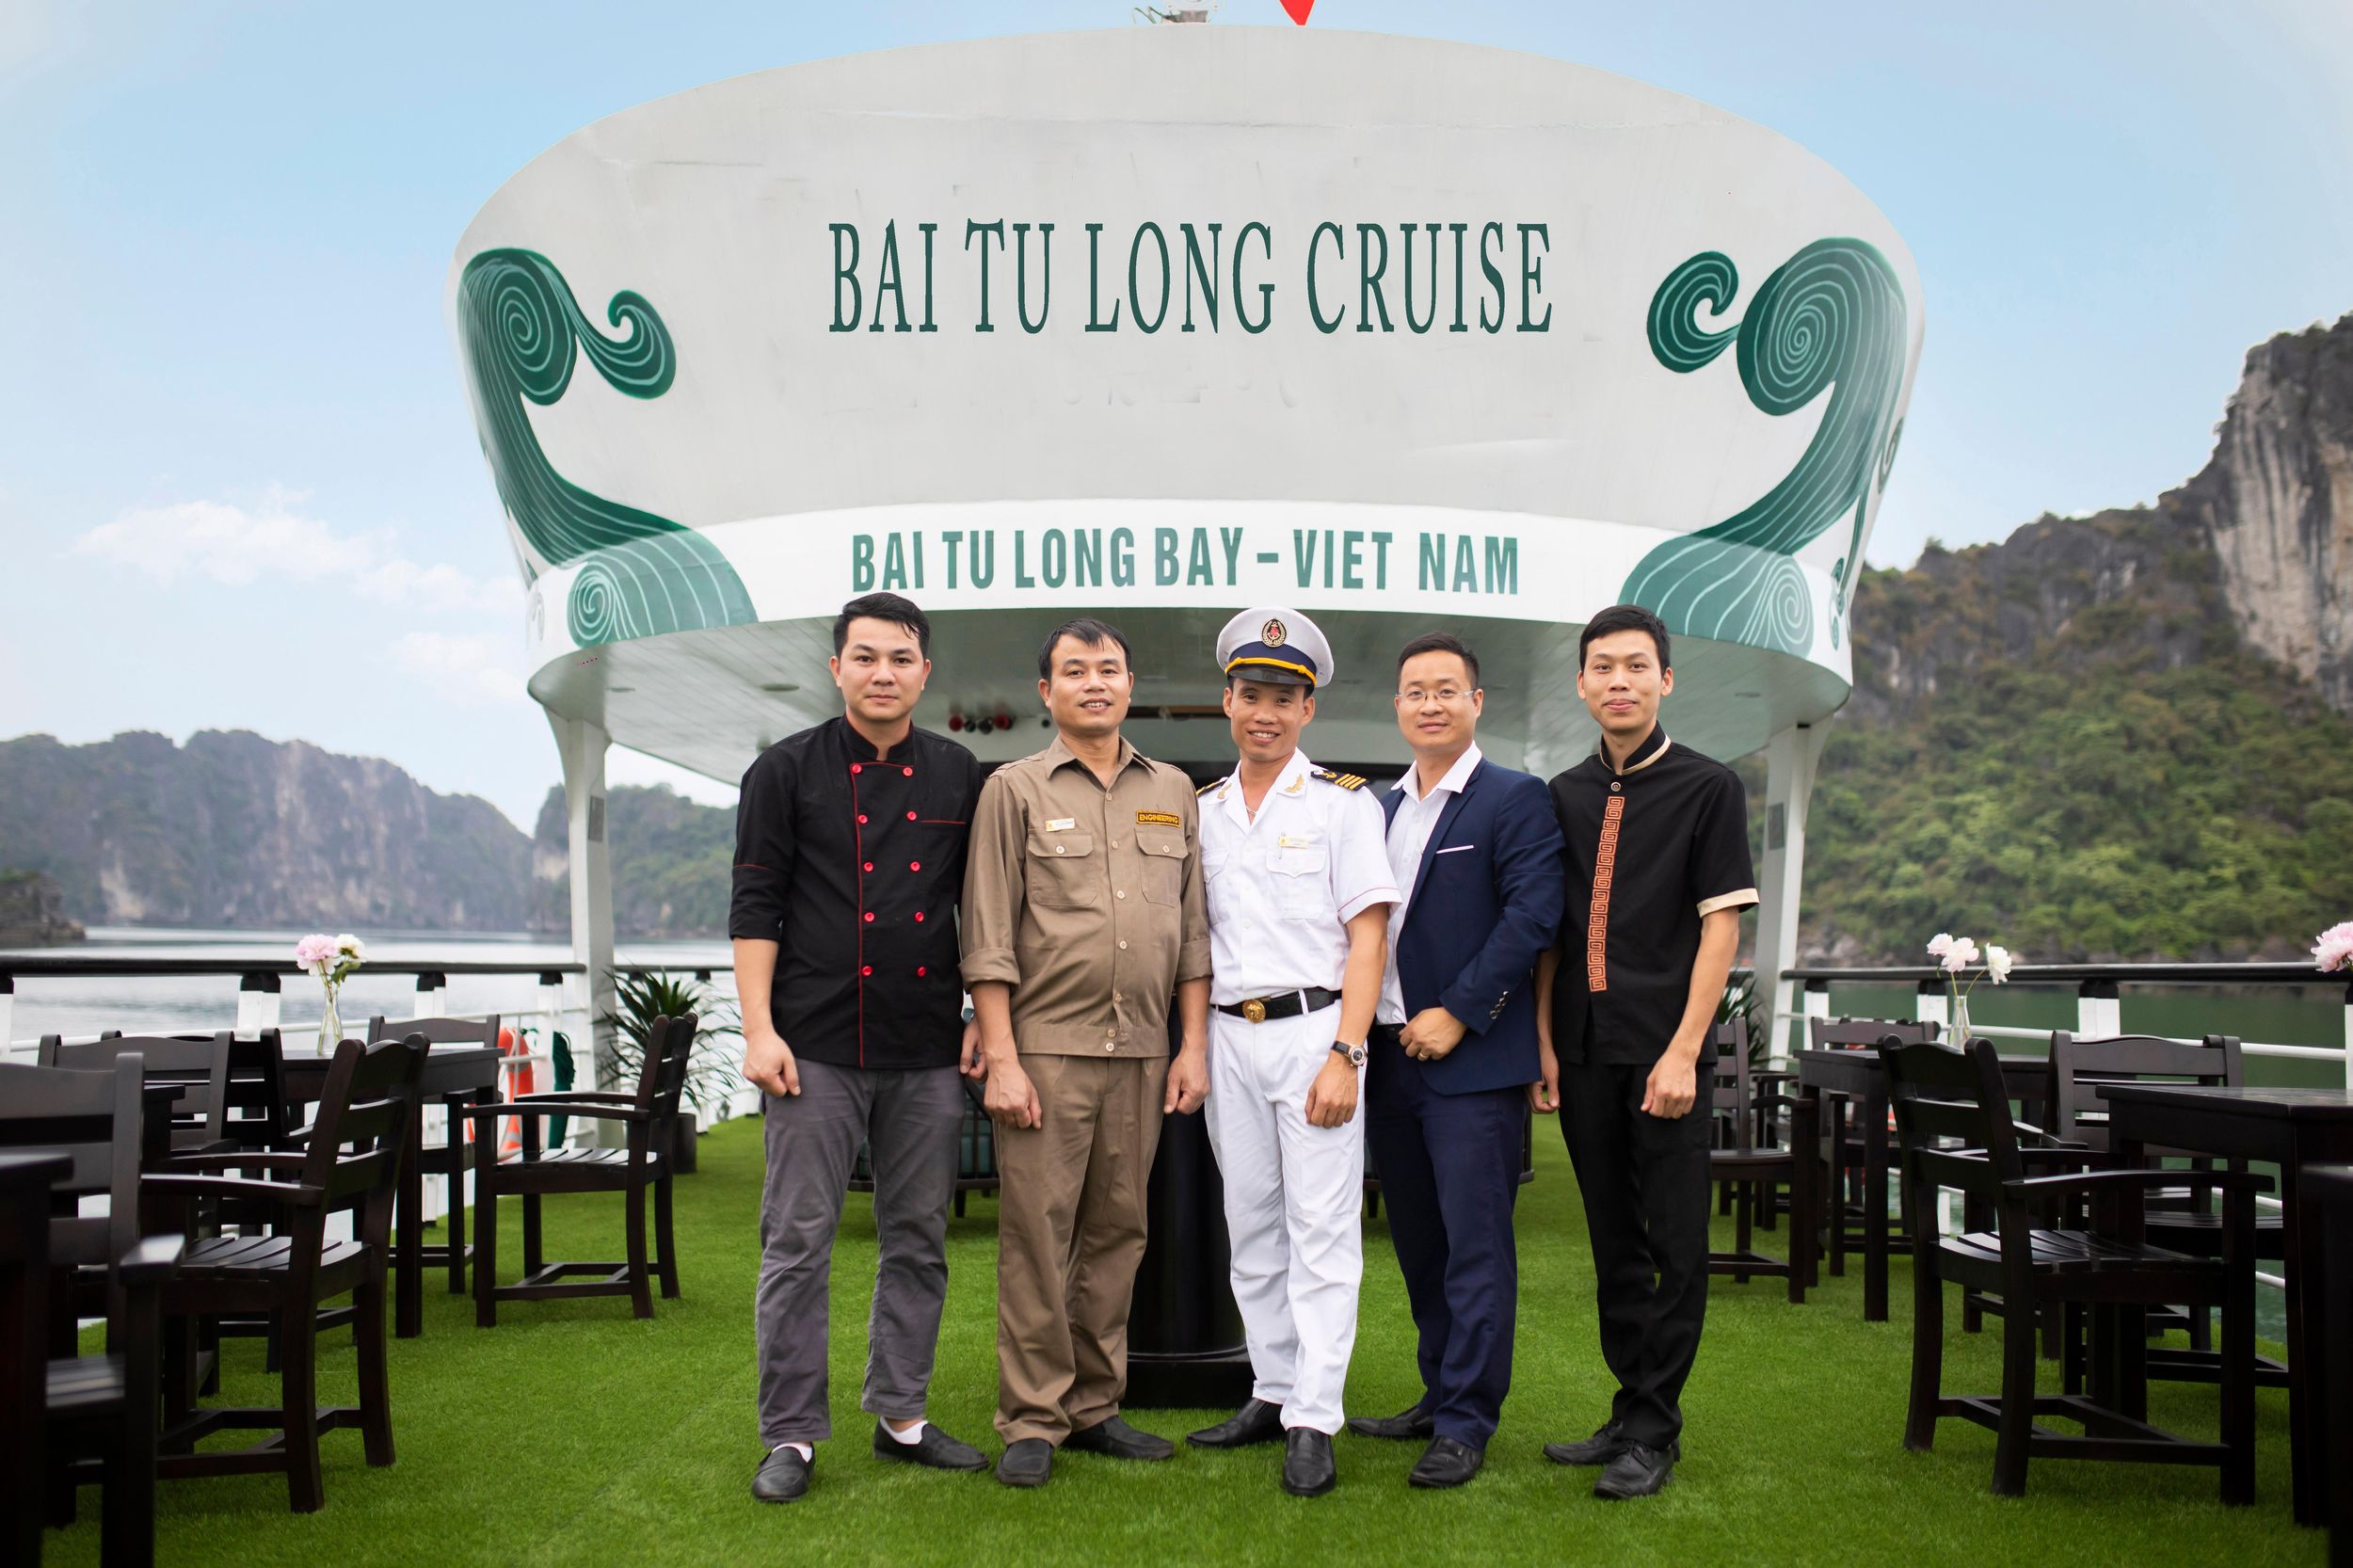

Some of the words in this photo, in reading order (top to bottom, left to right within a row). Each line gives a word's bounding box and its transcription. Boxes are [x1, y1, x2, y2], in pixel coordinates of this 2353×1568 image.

[828, 218, 939, 333] BAI
[964, 217, 1055, 335] TU
[1083, 219, 1276, 335] LONG
[1305, 220, 1553, 335] CRUISE
[850, 528, 924, 594] BAI
[939, 527, 995, 590] TU
[1013, 526, 1136, 588] LONG
[1154, 526, 1245, 587] BAY
[1291, 527, 1395, 592] VIET
[1417, 530, 1519, 596] NAM
[1139, 813, 1178, 824] ENGINEERING
